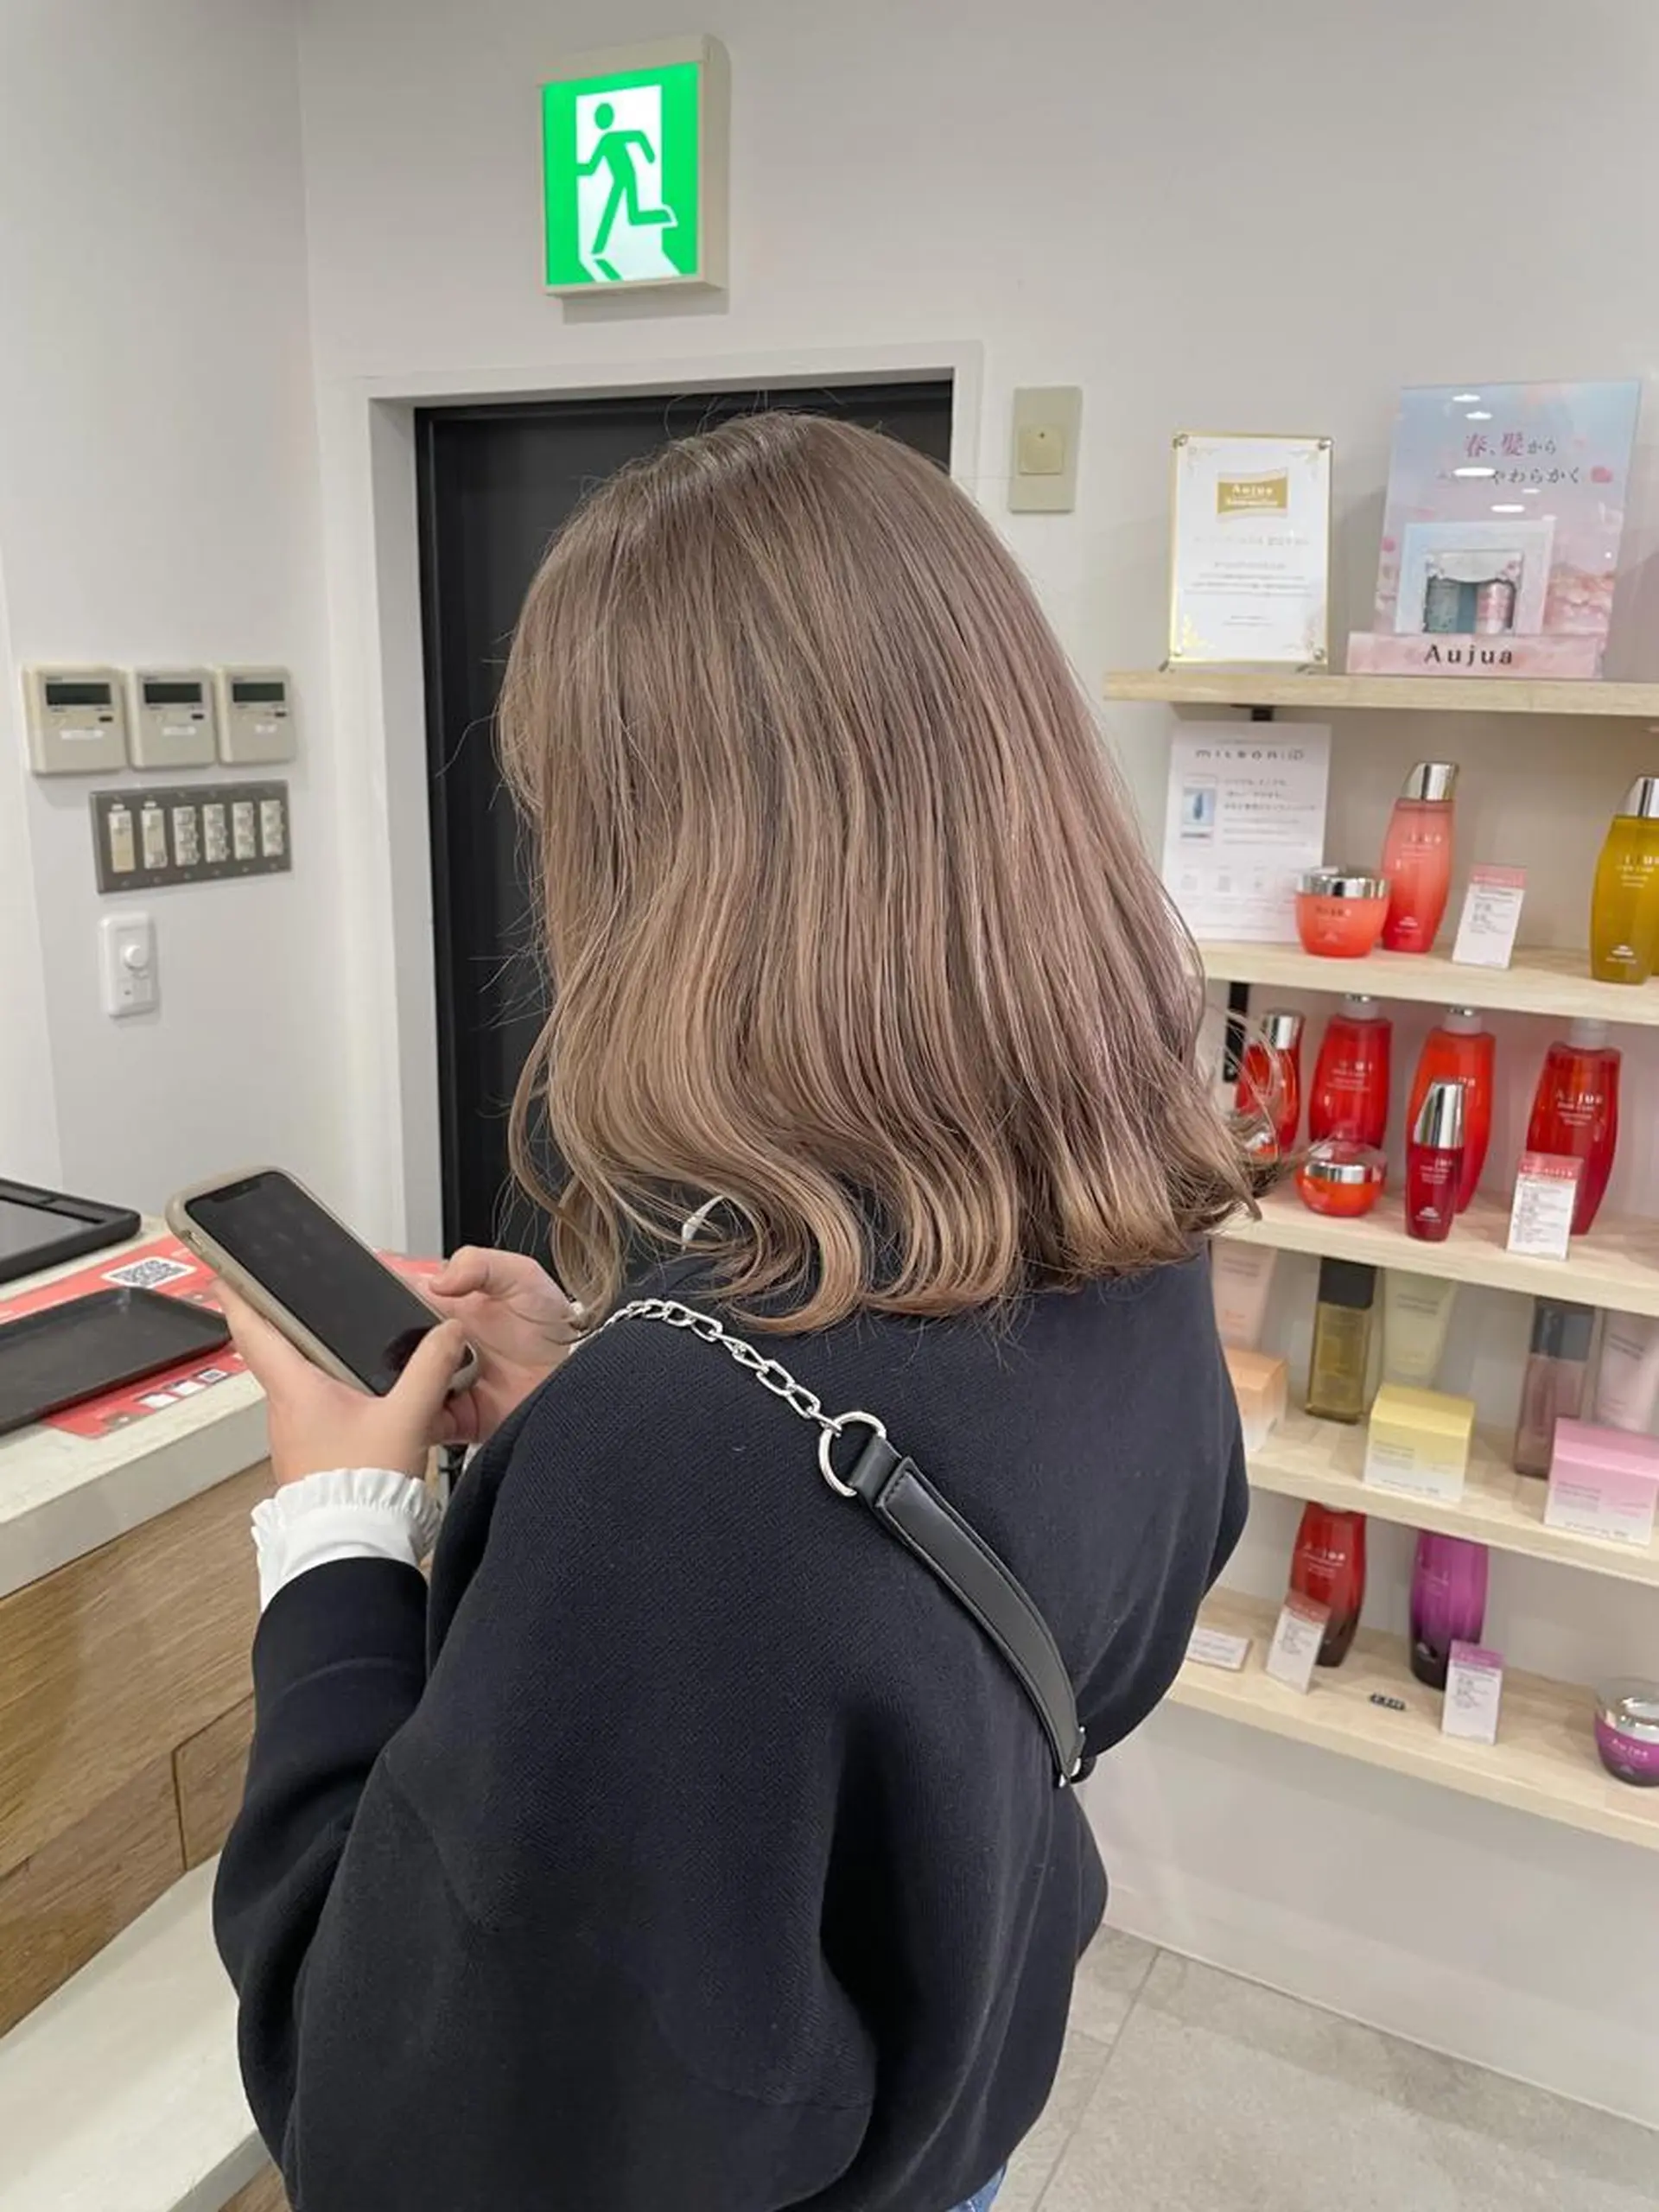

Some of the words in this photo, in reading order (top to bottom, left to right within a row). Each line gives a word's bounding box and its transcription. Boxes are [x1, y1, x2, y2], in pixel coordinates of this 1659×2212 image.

[1464, 432, 1557, 458] 春、髪から
[1423, 643, 1514, 668] Aujua
